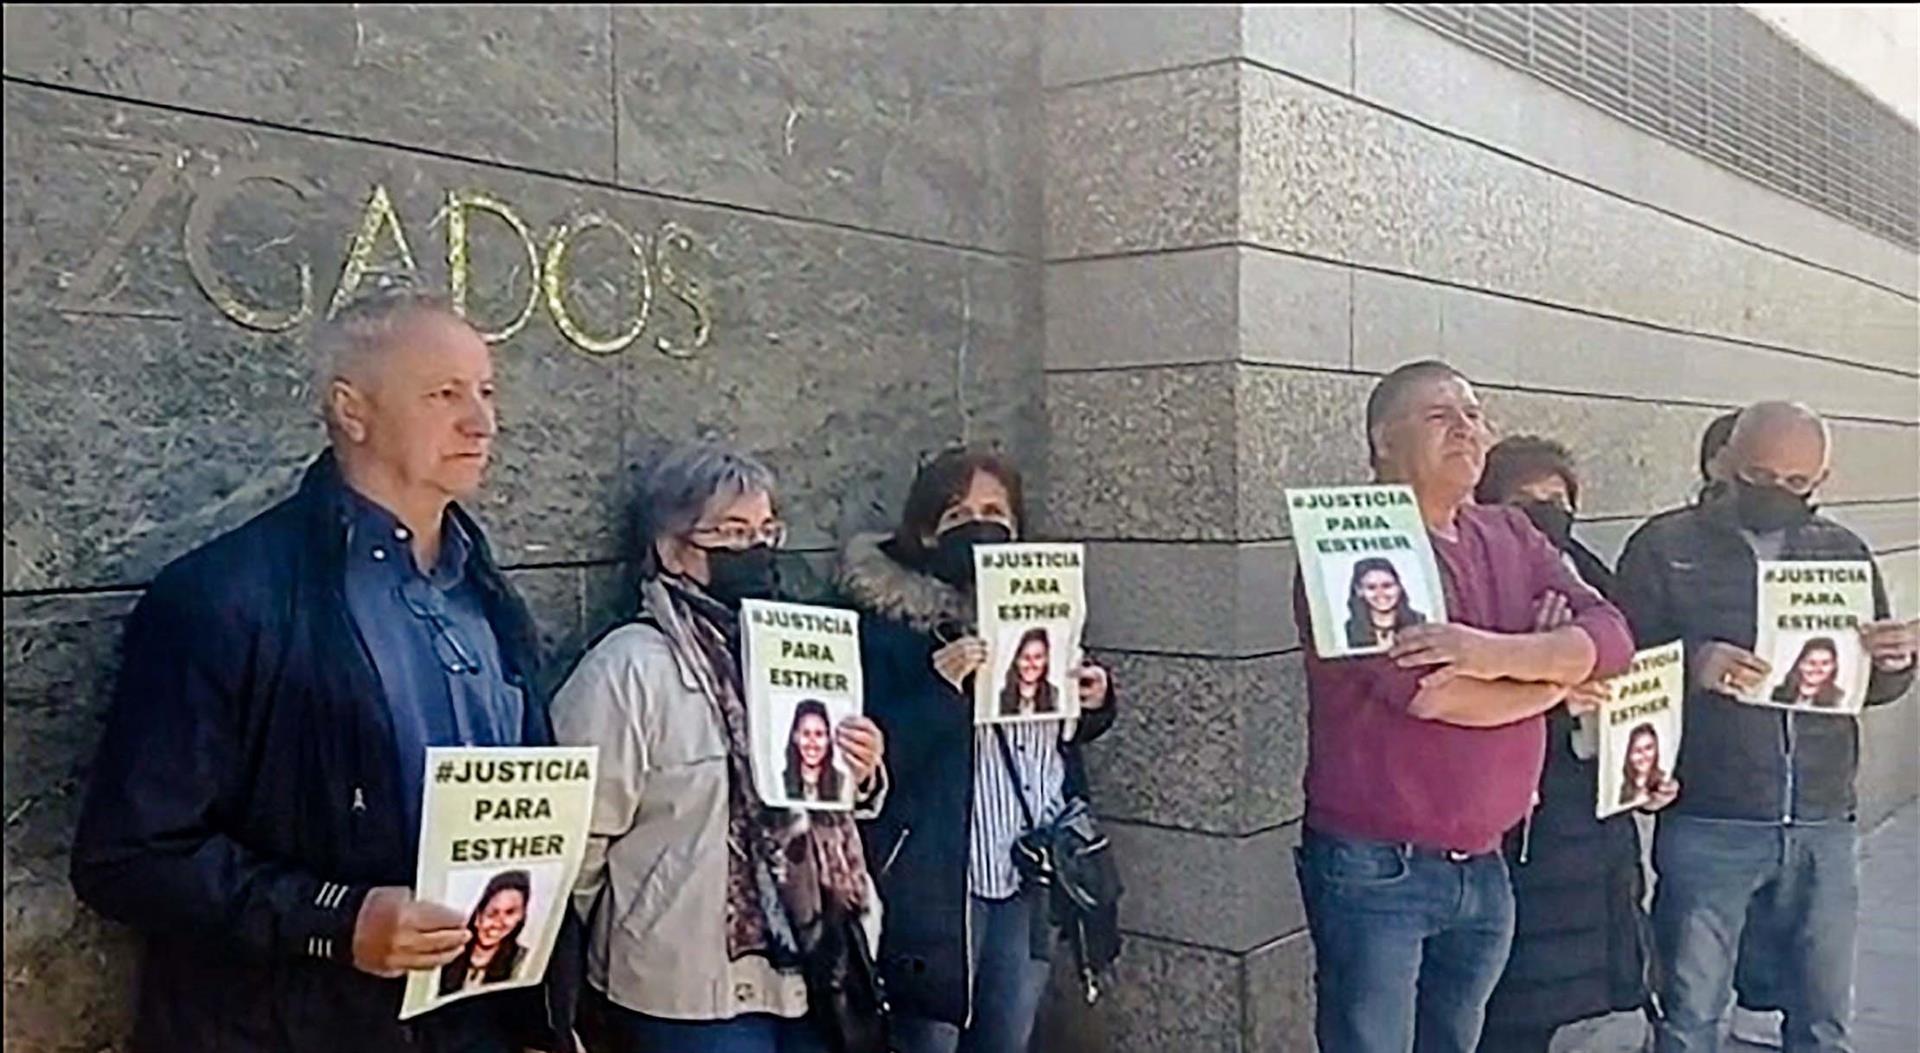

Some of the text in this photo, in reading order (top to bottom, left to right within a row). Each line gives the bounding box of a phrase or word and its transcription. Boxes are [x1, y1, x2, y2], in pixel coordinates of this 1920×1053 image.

[1293, 490, 1414, 509] #JUSTICIA
[1326, 515, 1390, 532] PARA
[1316, 535, 1412, 554] ESTHER
[982, 551, 1080, 569] #JUSTICIA
[1764, 568, 1867, 584] #JUSTICIA
[1010, 577, 1060, 595] PARA
[1790, 592, 1846, 606] PARA
[998, 604, 1071, 621] ESTHER
[1777, 614, 1861, 630] ESTHER
[752, 609, 854, 637] #JUSTICIA
[781, 640, 835, 663] PARA
[769, 667, 849, 692] ESTHER
[1618, 676, 1662, 699] PARA
[1610, 696, 1670, 725] ESTHER
[435, 760, 591, 783] #JUSTICIA
[474, 797, 553, 821] PARA
[451, 834, 565, 862] ESTHER
